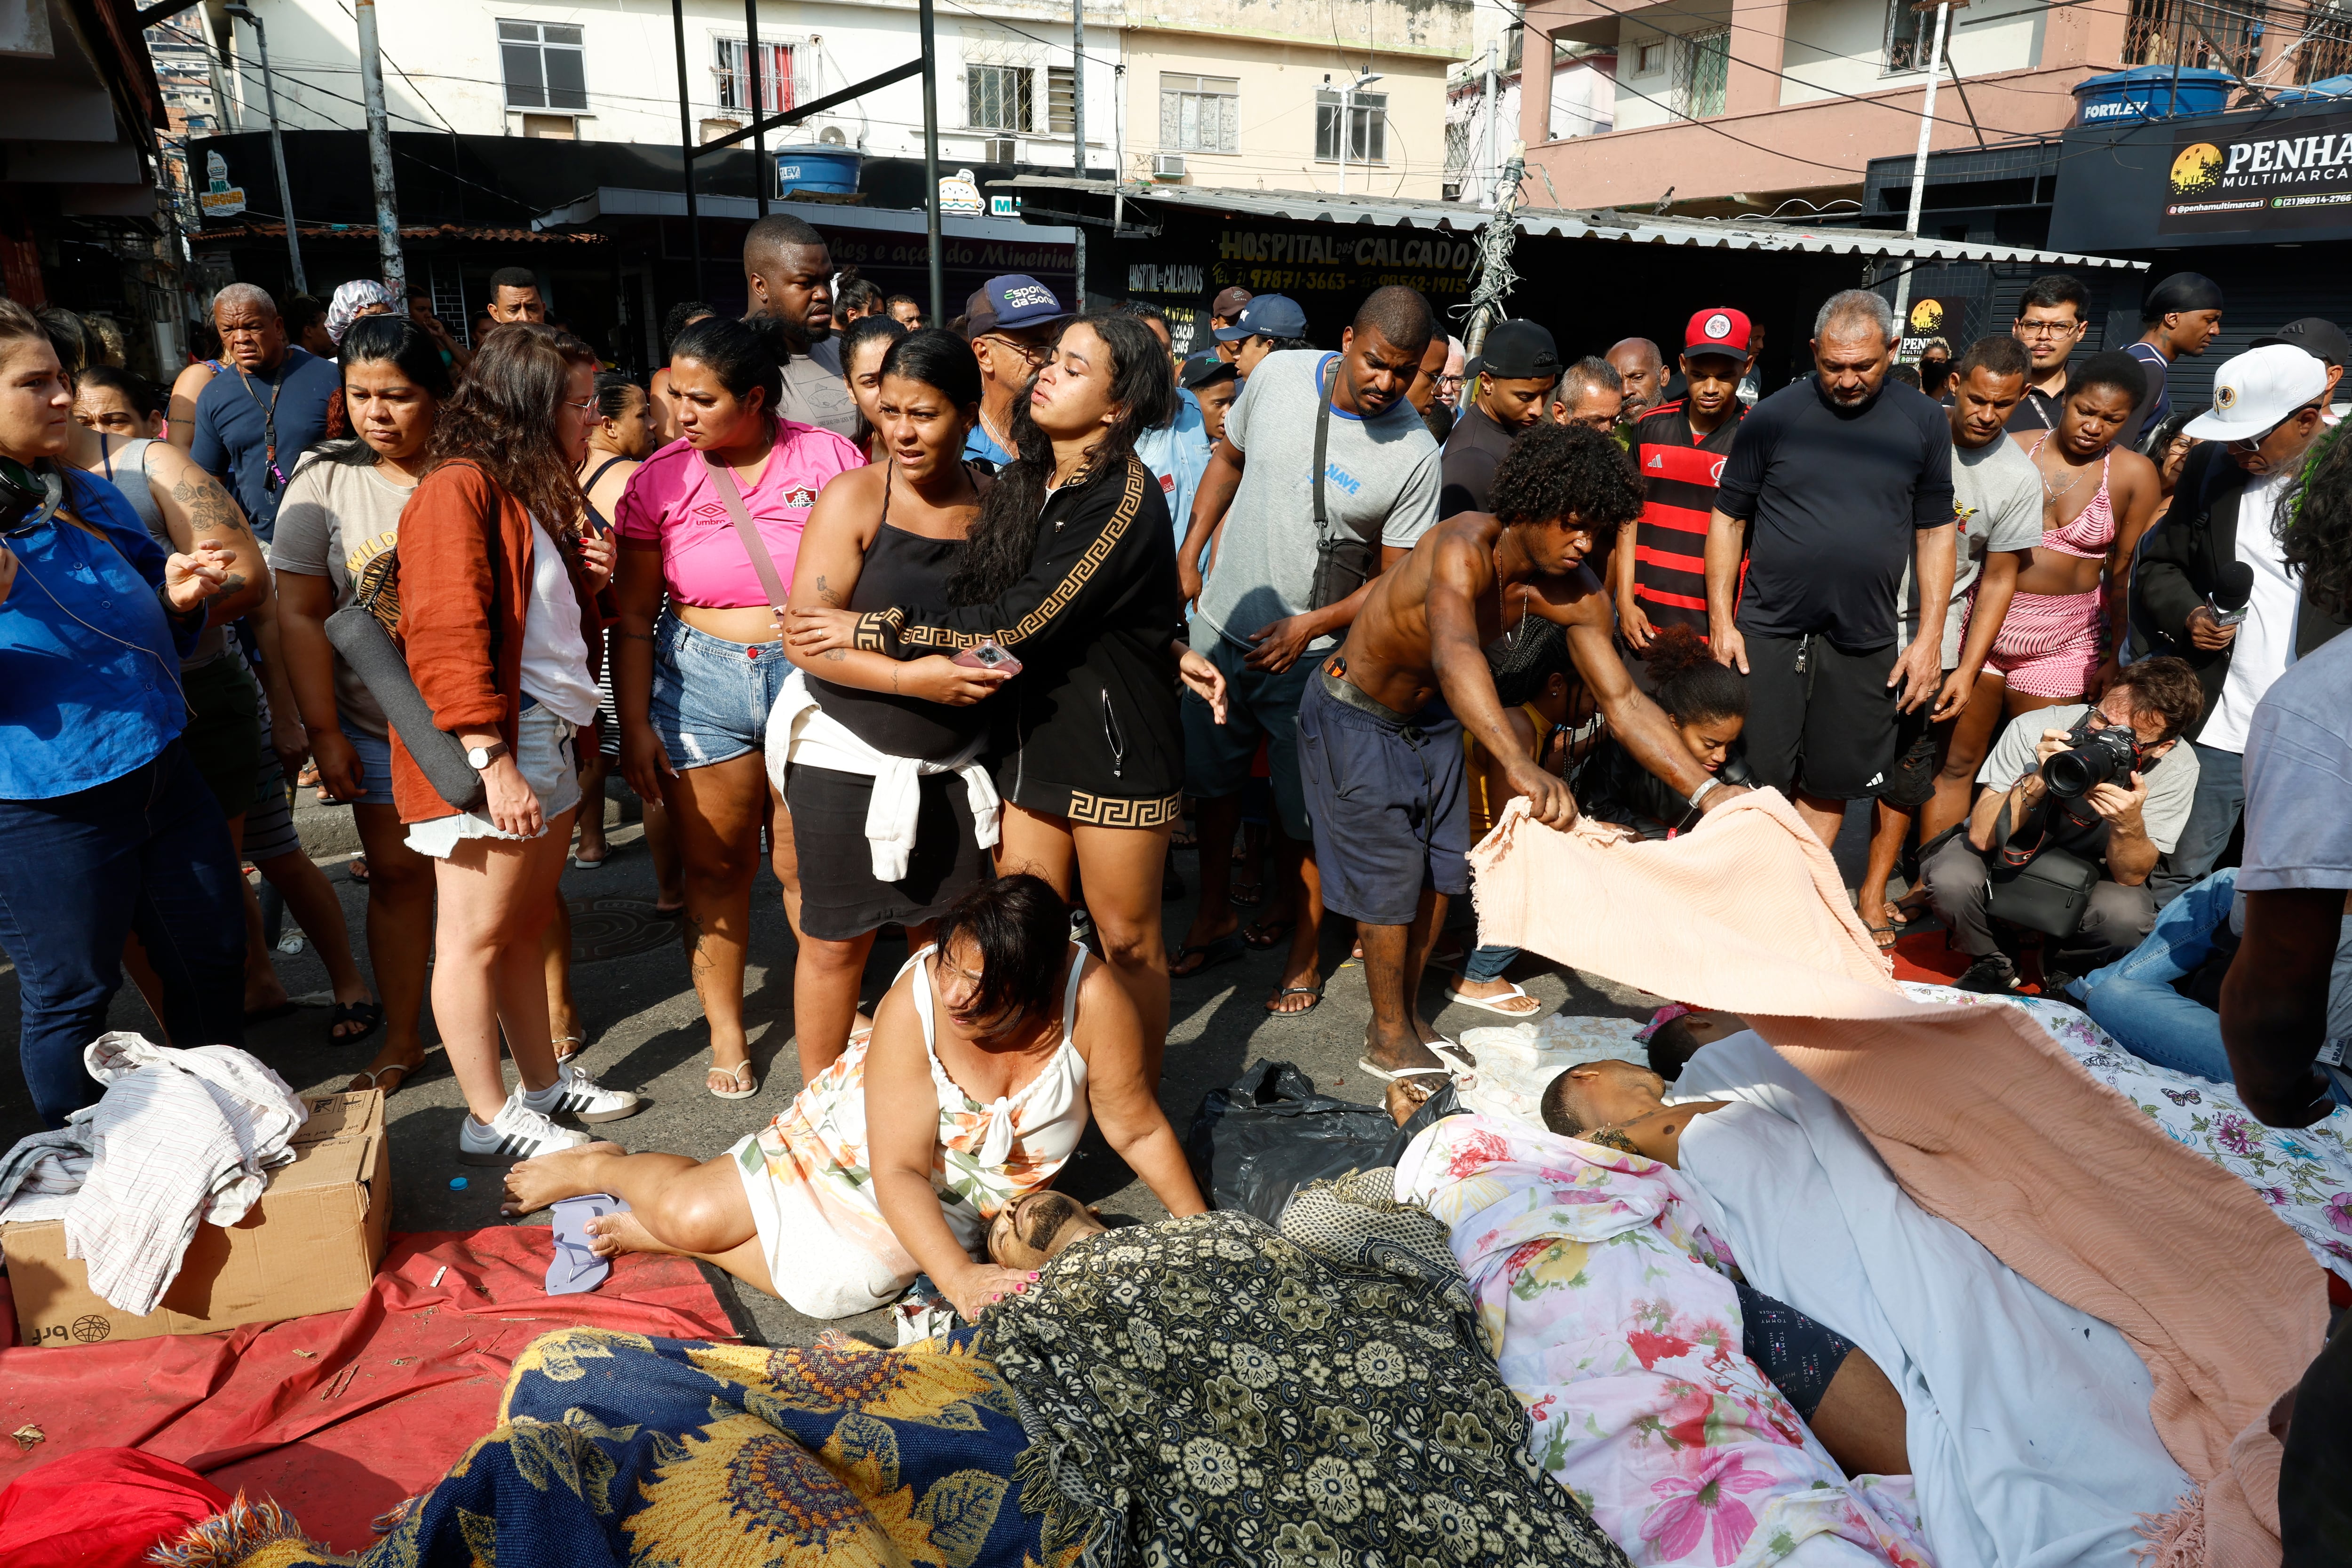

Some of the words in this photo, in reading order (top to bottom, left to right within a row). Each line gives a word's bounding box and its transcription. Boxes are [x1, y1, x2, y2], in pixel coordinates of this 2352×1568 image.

[211, 181, 230, 193] MR.
[2222, 167, 2352, 188] MULTIMARCA
[202, 191, 244, 207] BURGUER
[2177, 200, 2264, 213] @penhamultimarcas1
[2283, 194, 2352, 207] (21)96914-2766
[829, 237, 866, 262] hes
[874, 245, 886, 260] e
[892, 244, 929, 265] aça
[946, 241, 973, 263] do
[1219, 231, 1339, 264] HOSPITAL
[1129, 264, 1159, 292] HOSPITAL
[1004, 286, 1051, 300] Esportes
[1012, 298, 1029, 308] da
[1027, 294, 1056, 306] Sorte
[1165, 306, 1194, 322] PINTURA
[345, 531, 397, 573] WILD
[505, 1105, 516, 1119] adidas
[32, 1325, 69, 1346] brf
[1779, 1331, 1788, 1361] TOMMY
[1771, 1371, 1796, 1384] HILFIGE
[1802, 1355, 1811, 1389] TOMMY
[1812, 1353, 1822, 1385] HILFIGER
[1800, 1405, 1817, 1416] TOM
